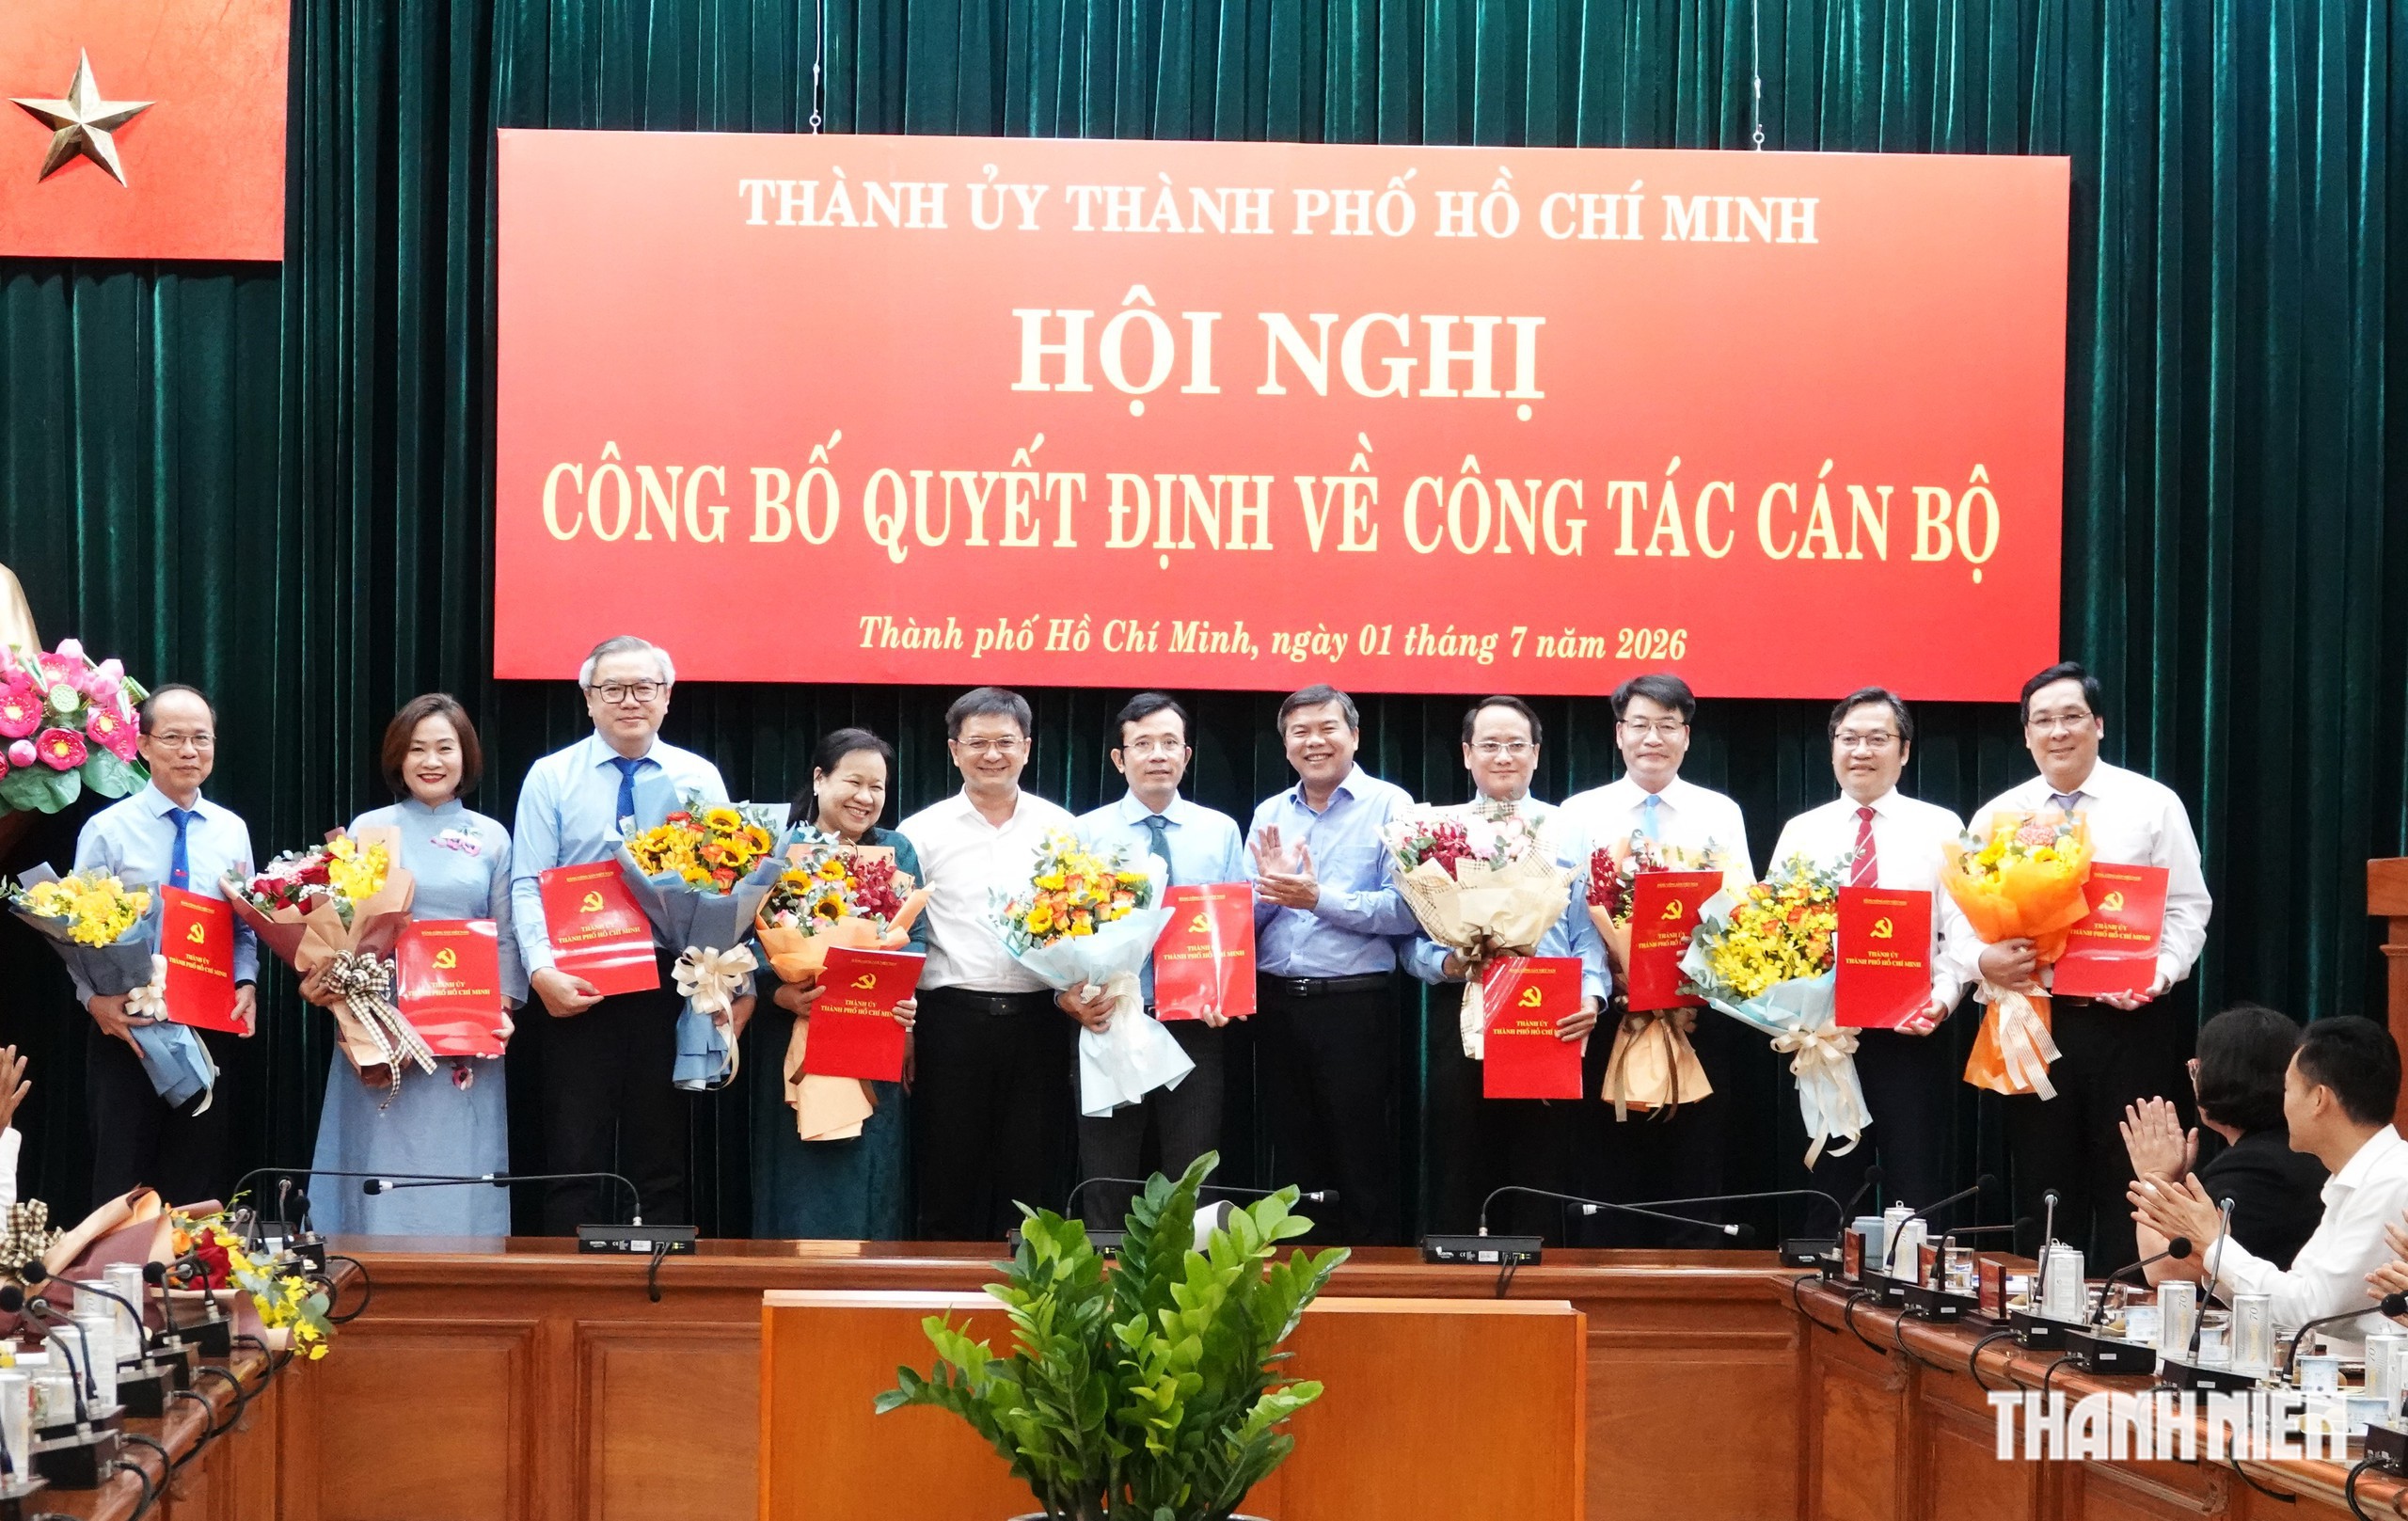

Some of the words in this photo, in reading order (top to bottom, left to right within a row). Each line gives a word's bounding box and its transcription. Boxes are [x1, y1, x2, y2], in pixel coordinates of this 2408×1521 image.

[739, 166, 947, 228] THÀNH
[968, 165, 1048, 231] ỦY
[1067, 173, 1273, 233] THÀNH
[1293, 169, 1416, 236] PHỐ
[1435, 166, 1519, 238] HỒ
[1541, 181, 1643, 240] CHÍ
[1662, 197, 1818, 243] MINH
[1011, 285, 1221, 417] HỘI
[1257, 313, 1545, 421] NGHỊ
[543, 440, 730, 543] CÔNG
[750, 429, 842, 545] BỐ
[863, 433, 1086, 564] QUYẾT
[1105, 473, 1275, 570] ĐỊNH
[1293, 432, 1378, 552] VỀ
[1403, 454, 1587, 556] CÔNG
[1608, 455, 1735, 559] TÁC
[1758, 458, 1893, 561] CÁN
[1911, 452, 2000, 583] BỘ
[860, 615, 963, 649] Thành
[971, 613, 1039, 658] phố
[1044, 613, 1091, 651] Hồ
[1102, 619, 1160, 653] Chí
[1168, 621, 1259, 660] Minh,
[1272, 623, 1348, 663] ngày
[1359, 624, 1392, 656] 01
[1404, 624, 1498, 665] tháng
[1511, 626, 1528, 658] 7
[1536, 627, 1606, 658] năm
[1615, 628, 1687, 660] 2026
